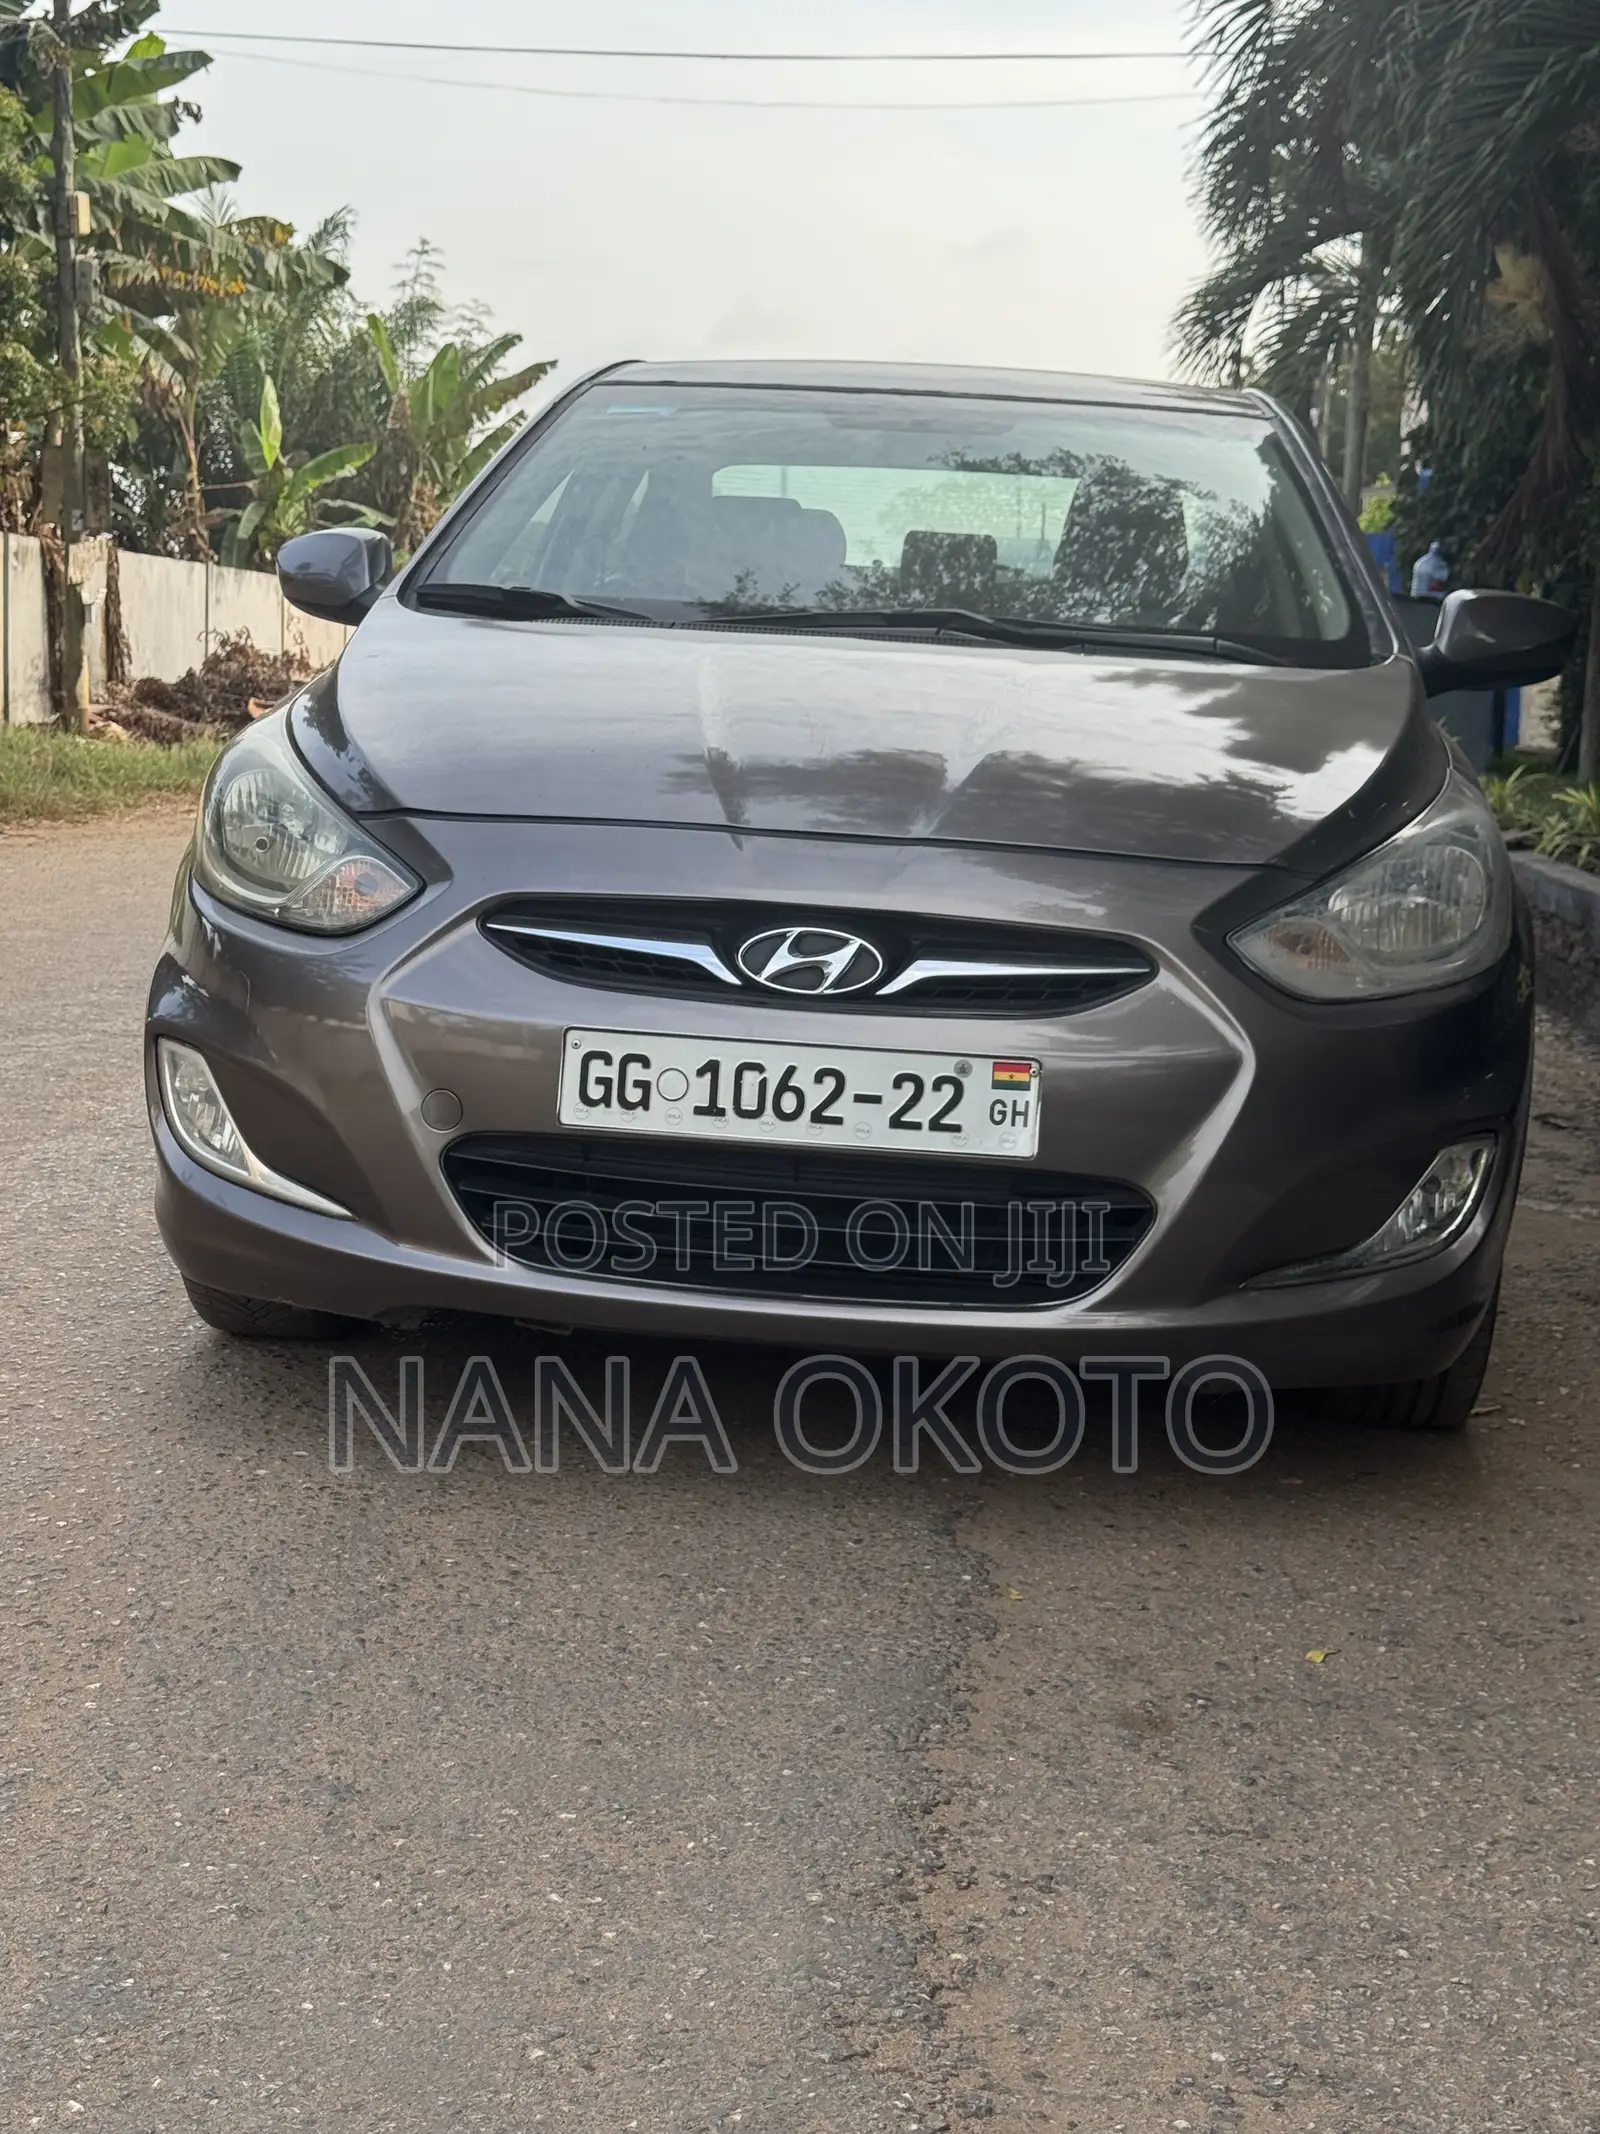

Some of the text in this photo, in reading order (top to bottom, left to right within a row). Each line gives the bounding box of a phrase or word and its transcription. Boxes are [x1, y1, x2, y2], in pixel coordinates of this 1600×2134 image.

[579, 1050, 965, 1133] GG 1062-22
[988, 1098, 1030, 1128] GH
